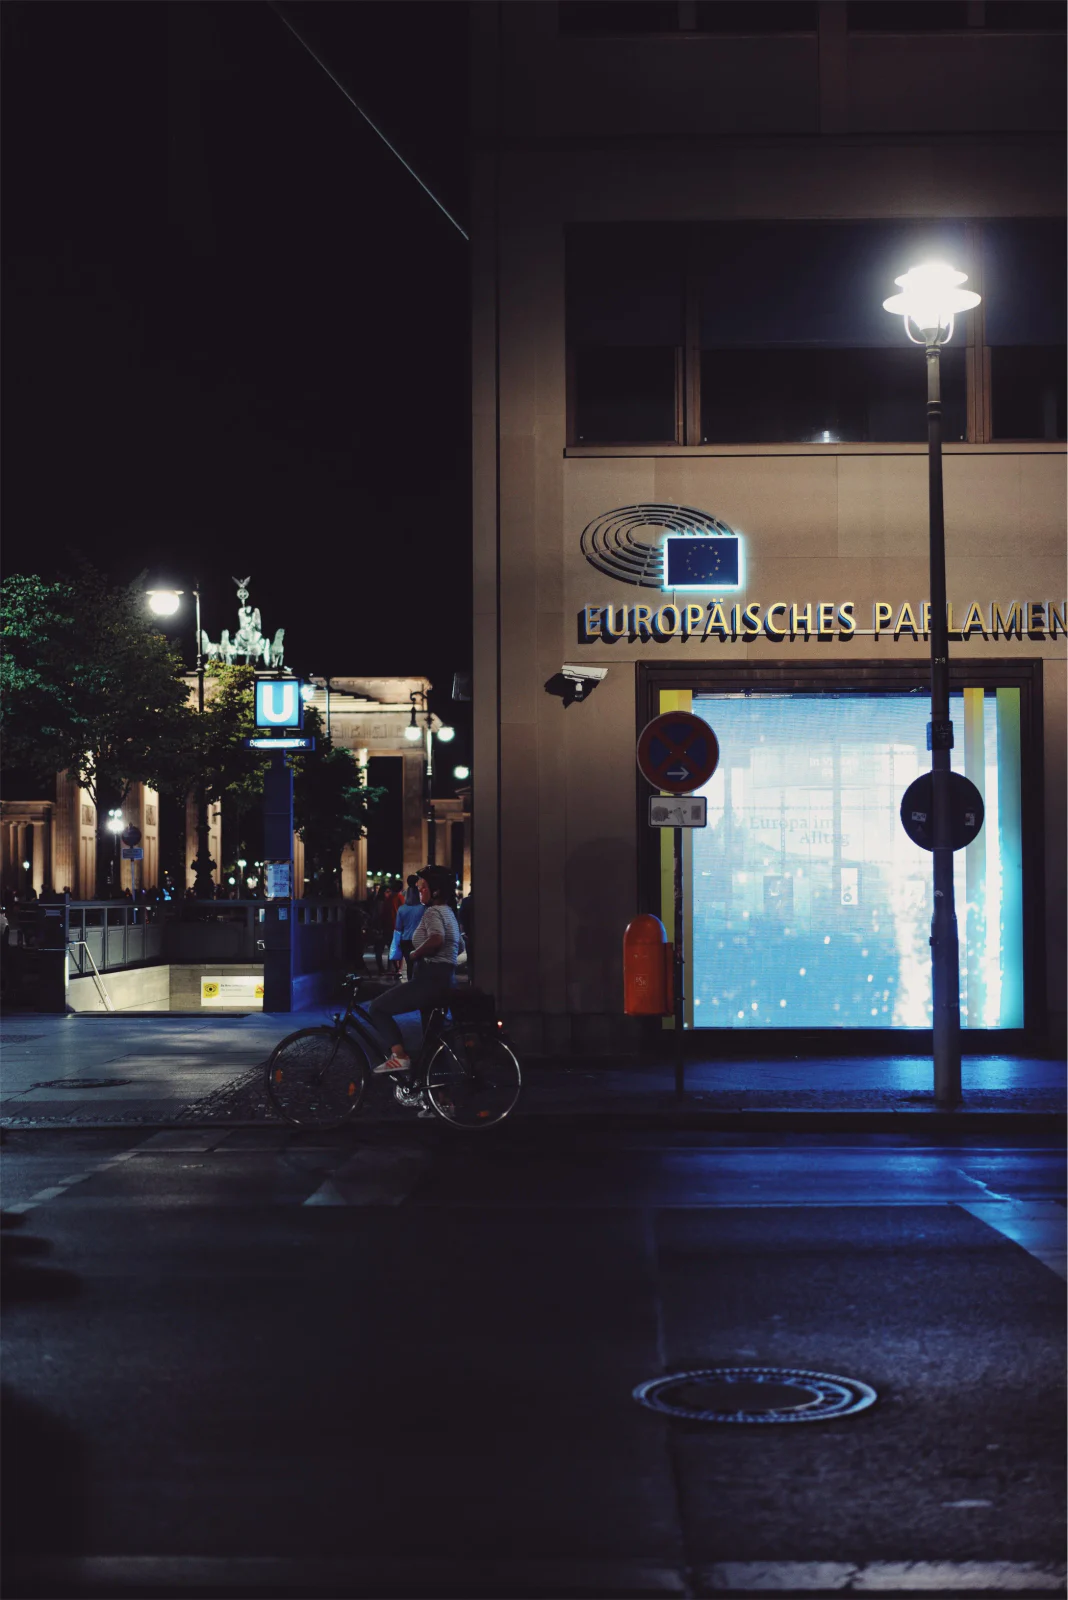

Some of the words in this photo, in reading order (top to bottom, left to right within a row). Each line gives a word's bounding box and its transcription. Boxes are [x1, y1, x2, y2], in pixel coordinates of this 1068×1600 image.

[585, 598, 855, 636] EUROPÄISCHES
[263, 685, 293, 722] U
[749, 815, 808, 832] Europa
[800, 830, 851, 847] Alltg
